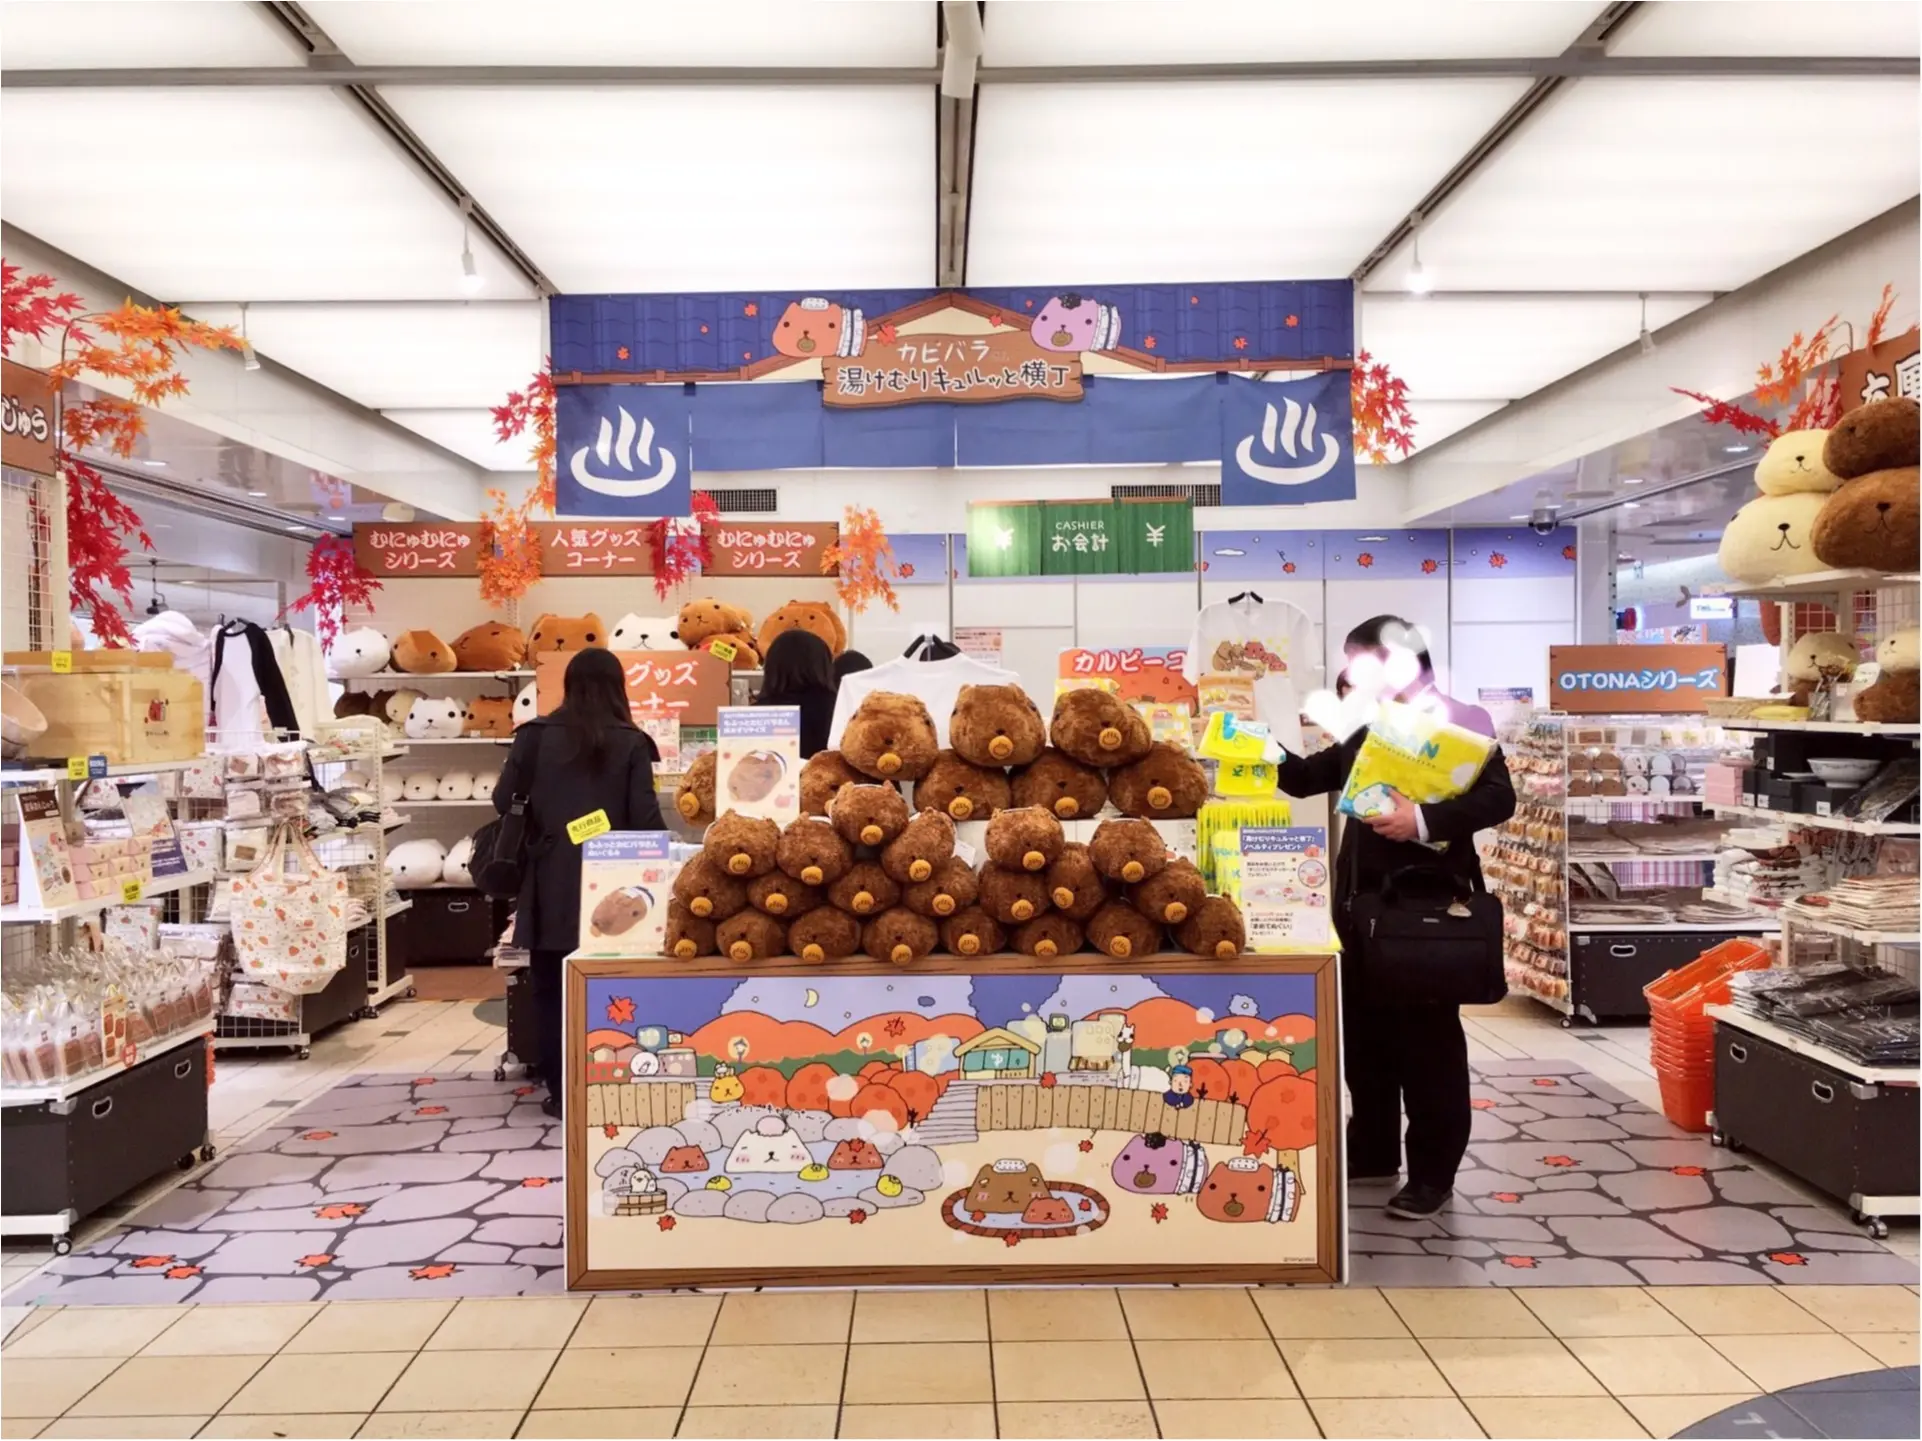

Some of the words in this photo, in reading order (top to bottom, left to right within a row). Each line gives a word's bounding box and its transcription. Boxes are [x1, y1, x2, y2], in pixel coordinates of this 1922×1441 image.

[836, 360, 1071, 397] 湯けむりキュルッと横丁
[1055, 520, 1105, 531] CASHIER
[369, 530, 471, 549] むにゅむにゅ
[551, 529, 642, 548] 人気グッズ
[718, 530, 816, 549] むにゅむにゅ
[1051, 533, 1109, 553] お会計
[385, 551, 457, 568] シリーズ
[566, 552, 636, 568] コーナー
[732, 551, 801, 568] シリーズ
[1074, 650, 1188, 673] カルビーコ
[626, 660, 699, 687] グッズ
[1559, 667, 1720, 691] OTONAシリーズ
[630, 691, 690, 711] ーナー
